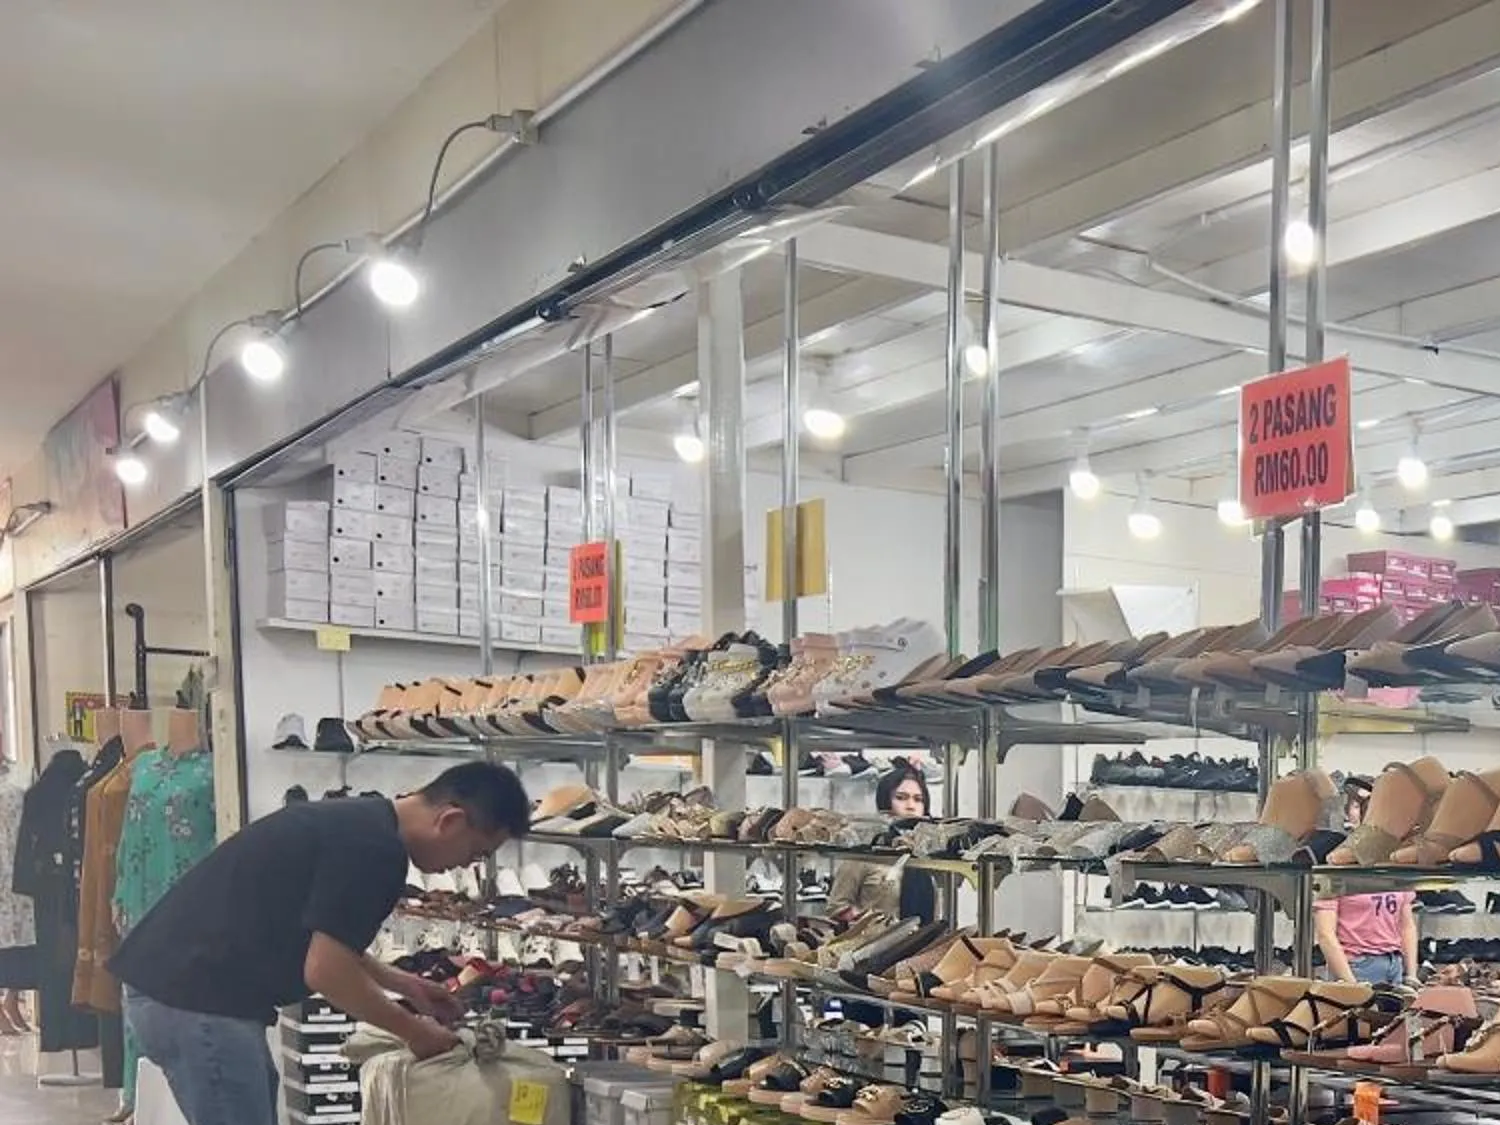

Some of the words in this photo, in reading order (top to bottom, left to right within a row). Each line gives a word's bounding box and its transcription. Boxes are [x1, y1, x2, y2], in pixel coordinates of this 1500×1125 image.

[1249, 403, 1259, 444] 2
[1263, 384, 1337, 441] PASANG
[1254, 441, 1329, 497] RM60.00
[1371, 894, 1397, 916] 76
